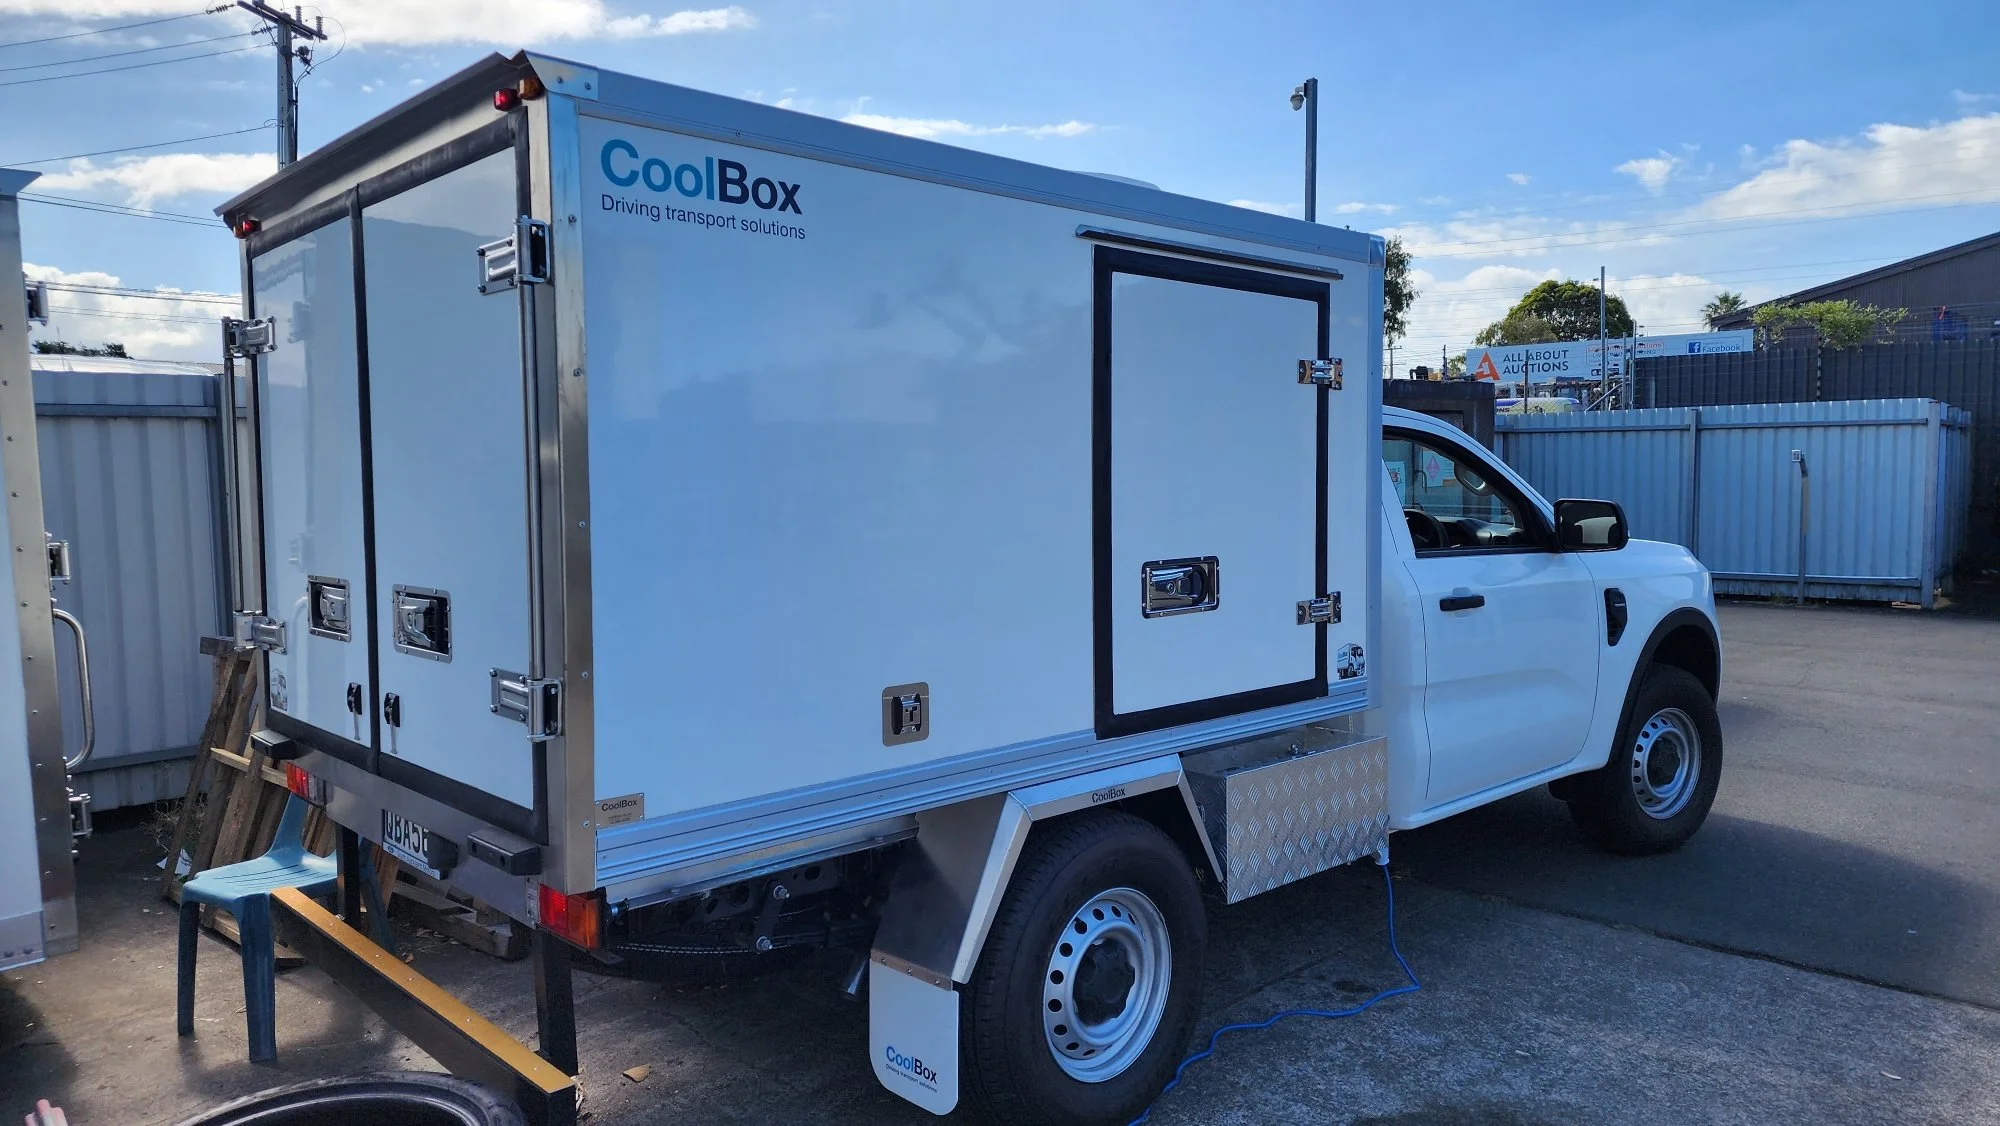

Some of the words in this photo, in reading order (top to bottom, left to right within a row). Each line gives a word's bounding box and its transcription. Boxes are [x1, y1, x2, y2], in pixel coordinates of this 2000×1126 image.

[601, 139, 803, 215] CoolBox
[602, 194, 660, 222] Driving
[665, 205, 736, 229] transport
[741, 219, 806, 240] solutions
[1703, 344, 1741, 353] Facebook
[1503, 353, 1524, 362] ALL
[1527, 350, 1569, 361] ABOUT
[1503, 361, 1569, 375] AUCTIONS
[1092, 788, 1126, 803] CoolBox
[601, 799, 638, 812] CoolBox
[886, 1045, 937, 1085] CoolBox
